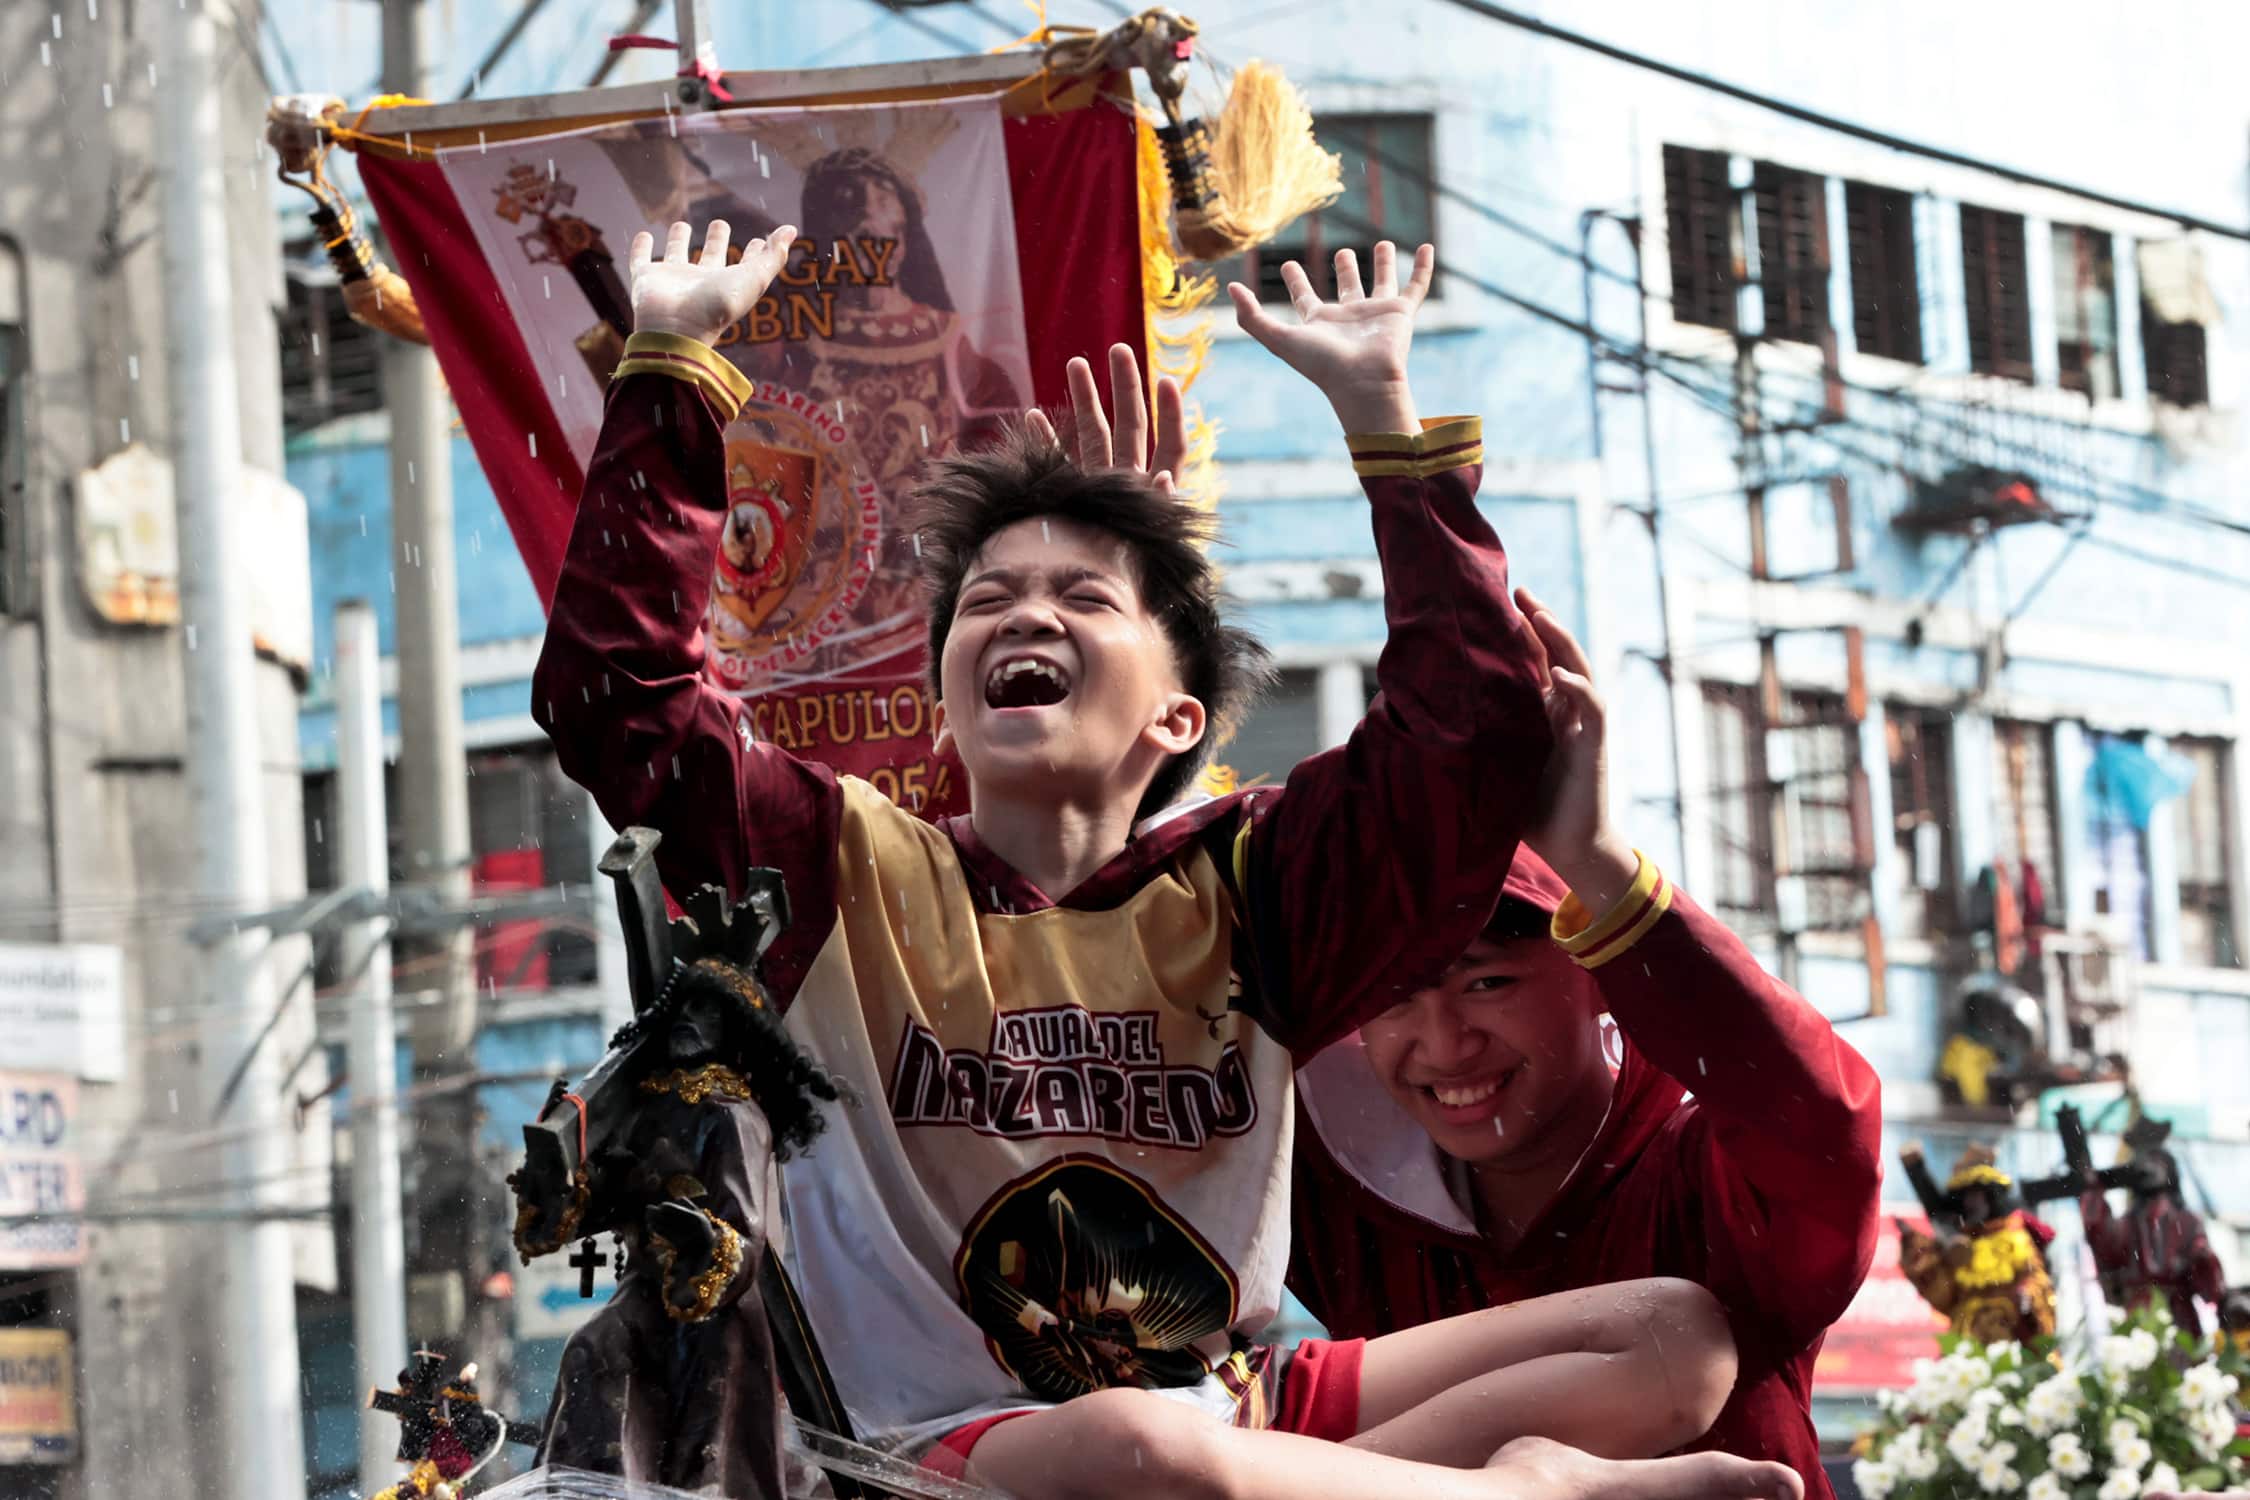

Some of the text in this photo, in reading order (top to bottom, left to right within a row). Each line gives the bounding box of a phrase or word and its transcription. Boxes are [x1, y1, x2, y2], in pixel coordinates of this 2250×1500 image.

[783, 608, 843, 663] BLACK
[754, 686, 934, 750] CAPULO
[1094, 1013, 1164, 1066] DEL
[893, 1012, 1258, 1152] NAZARENO
